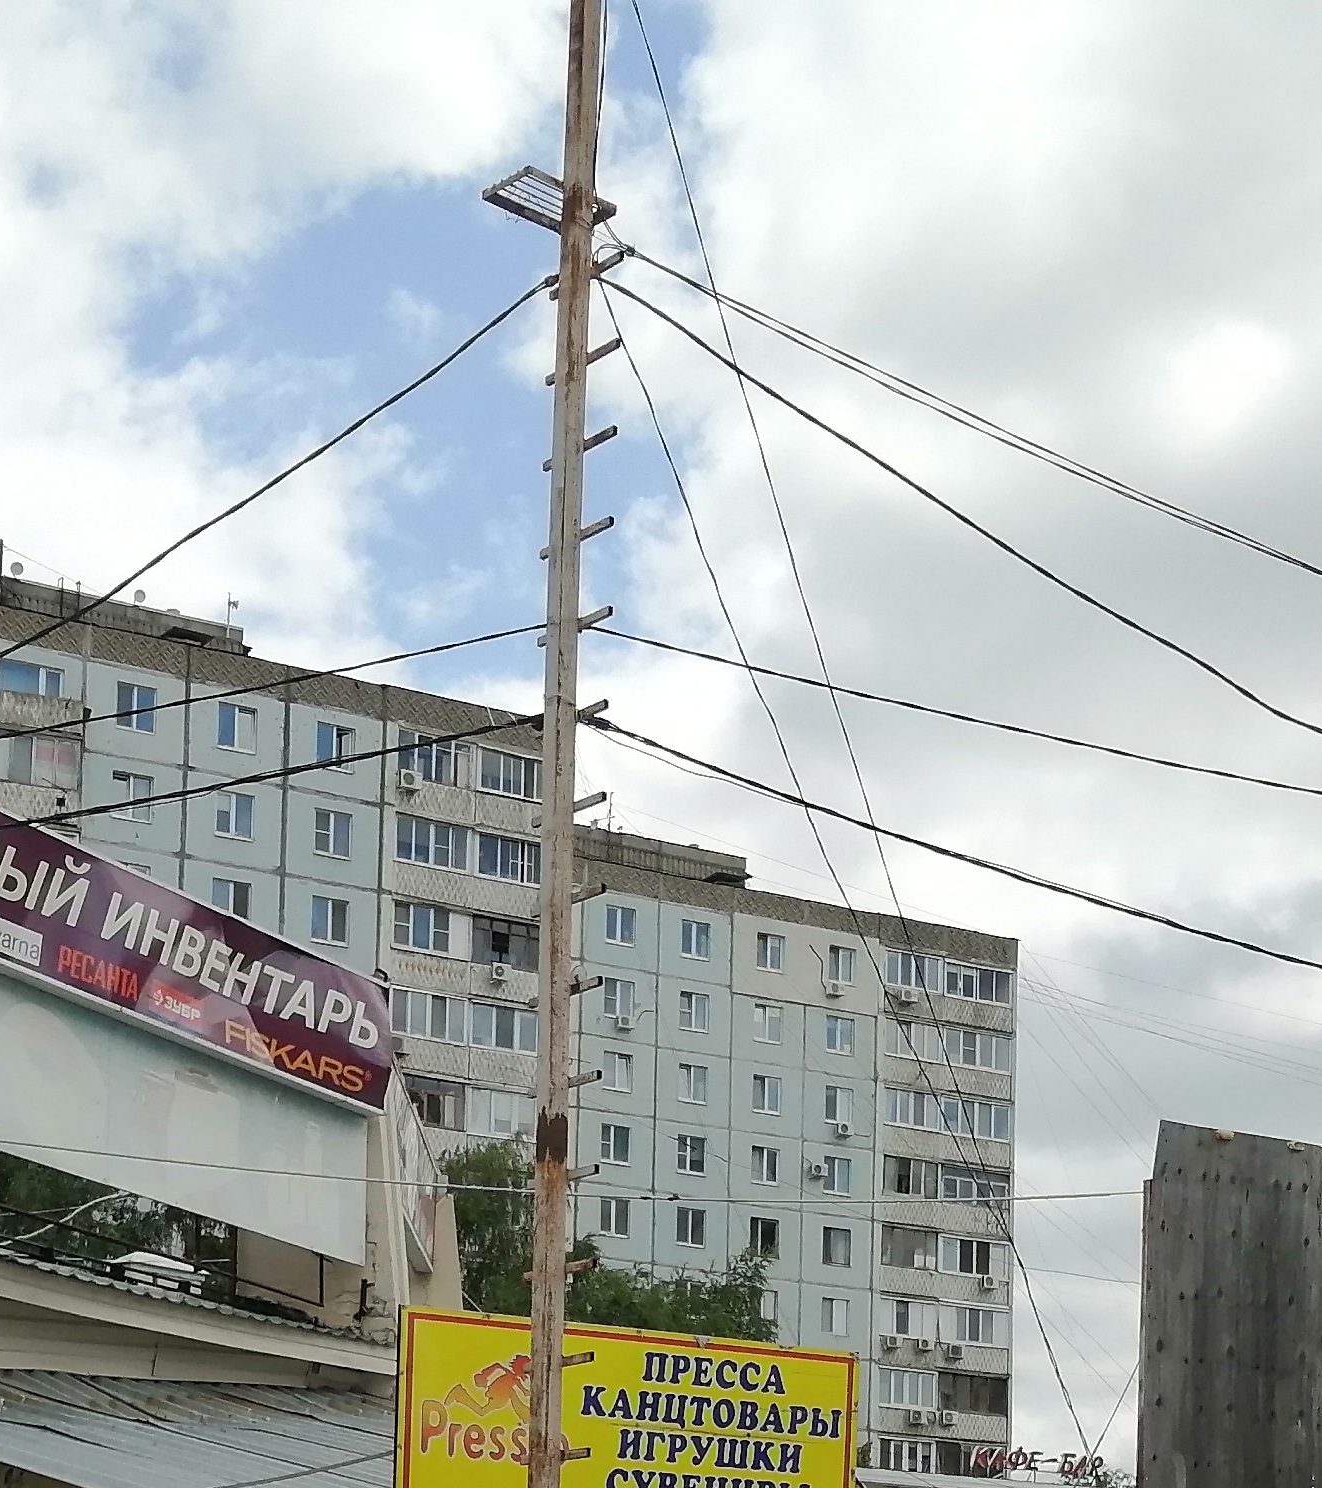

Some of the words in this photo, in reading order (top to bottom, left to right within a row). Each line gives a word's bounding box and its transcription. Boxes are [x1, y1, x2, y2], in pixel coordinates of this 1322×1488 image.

[57, 945, 139, 1001] РЕСАНТА
[101, 892, 379, 1050] ИНВЕНТАРЬ
[164, 996, 201, 1021] ЗУБР
[225, 1018, 366, 1092] FISKARS
[641, 1351, 786, 1395] ПРЕССА
[421, 1400, 569, 1466] Press
[580, 1385, 843, 1440] КАНЦТОВАРЫ
[616, 1429, 802, 1474] ИГРУШКИ
